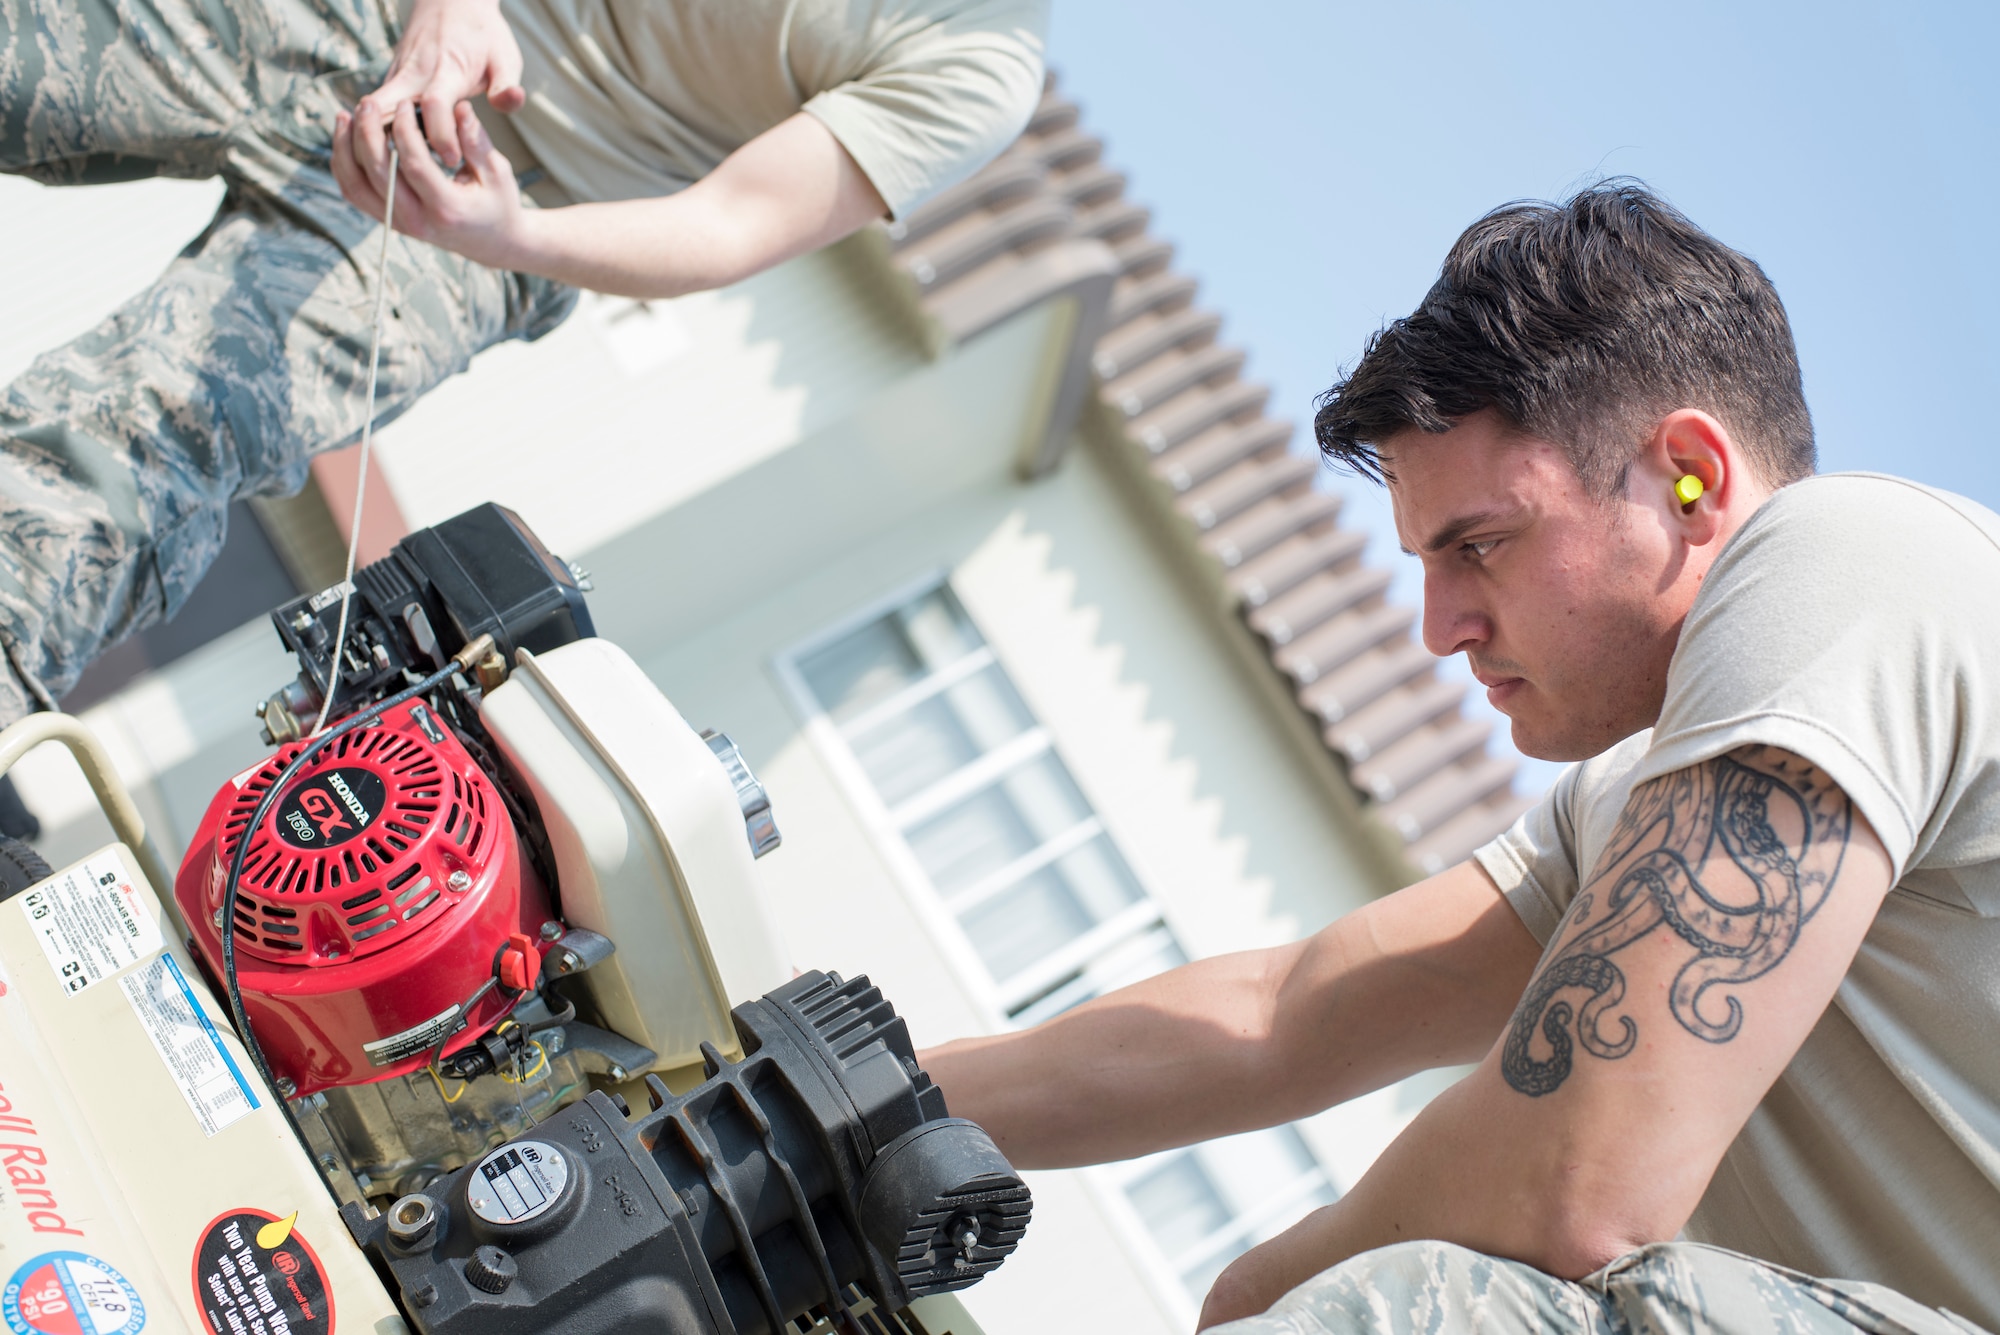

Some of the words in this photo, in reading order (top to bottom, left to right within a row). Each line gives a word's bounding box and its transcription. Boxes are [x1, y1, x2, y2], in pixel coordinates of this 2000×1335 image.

[299, 787, 353, 839] GX
[327, 771, 371, 827] HONDA
[285, 809, 317, 842] 160
[105, 886, 129, 919] 1-800-AIR
[123, 917, 140, 939] SERV
[485, 1166, 494, 1176] NO.
[489, 1160, 502, 1176] SERIAL
[503, 1152, 516, 1168] MODEL
[0, 1143, 85, 1237] Rand
[217, 1254, 236, 1278] with
[222, 1220, 244, 1251] Two
[235, 1245, 259, 1277] Year
[249, 1274, 278, 1314] Pump
[80, 1283, 101, 1308] CFM
[86, 1256, 144, 1335] COMPRESSOR
[93, 1279, 126, 1313] 11.8
[228, 1275, 245, 1295] use
[285, 1275, 304, 1307] Ingersoll
[299, 1303, 317, 1321] Rand
[20, 1295, 43, 1321] PSI
[237, 1293, 253, 1307] of
[242, 1302, 257, 1321] All
